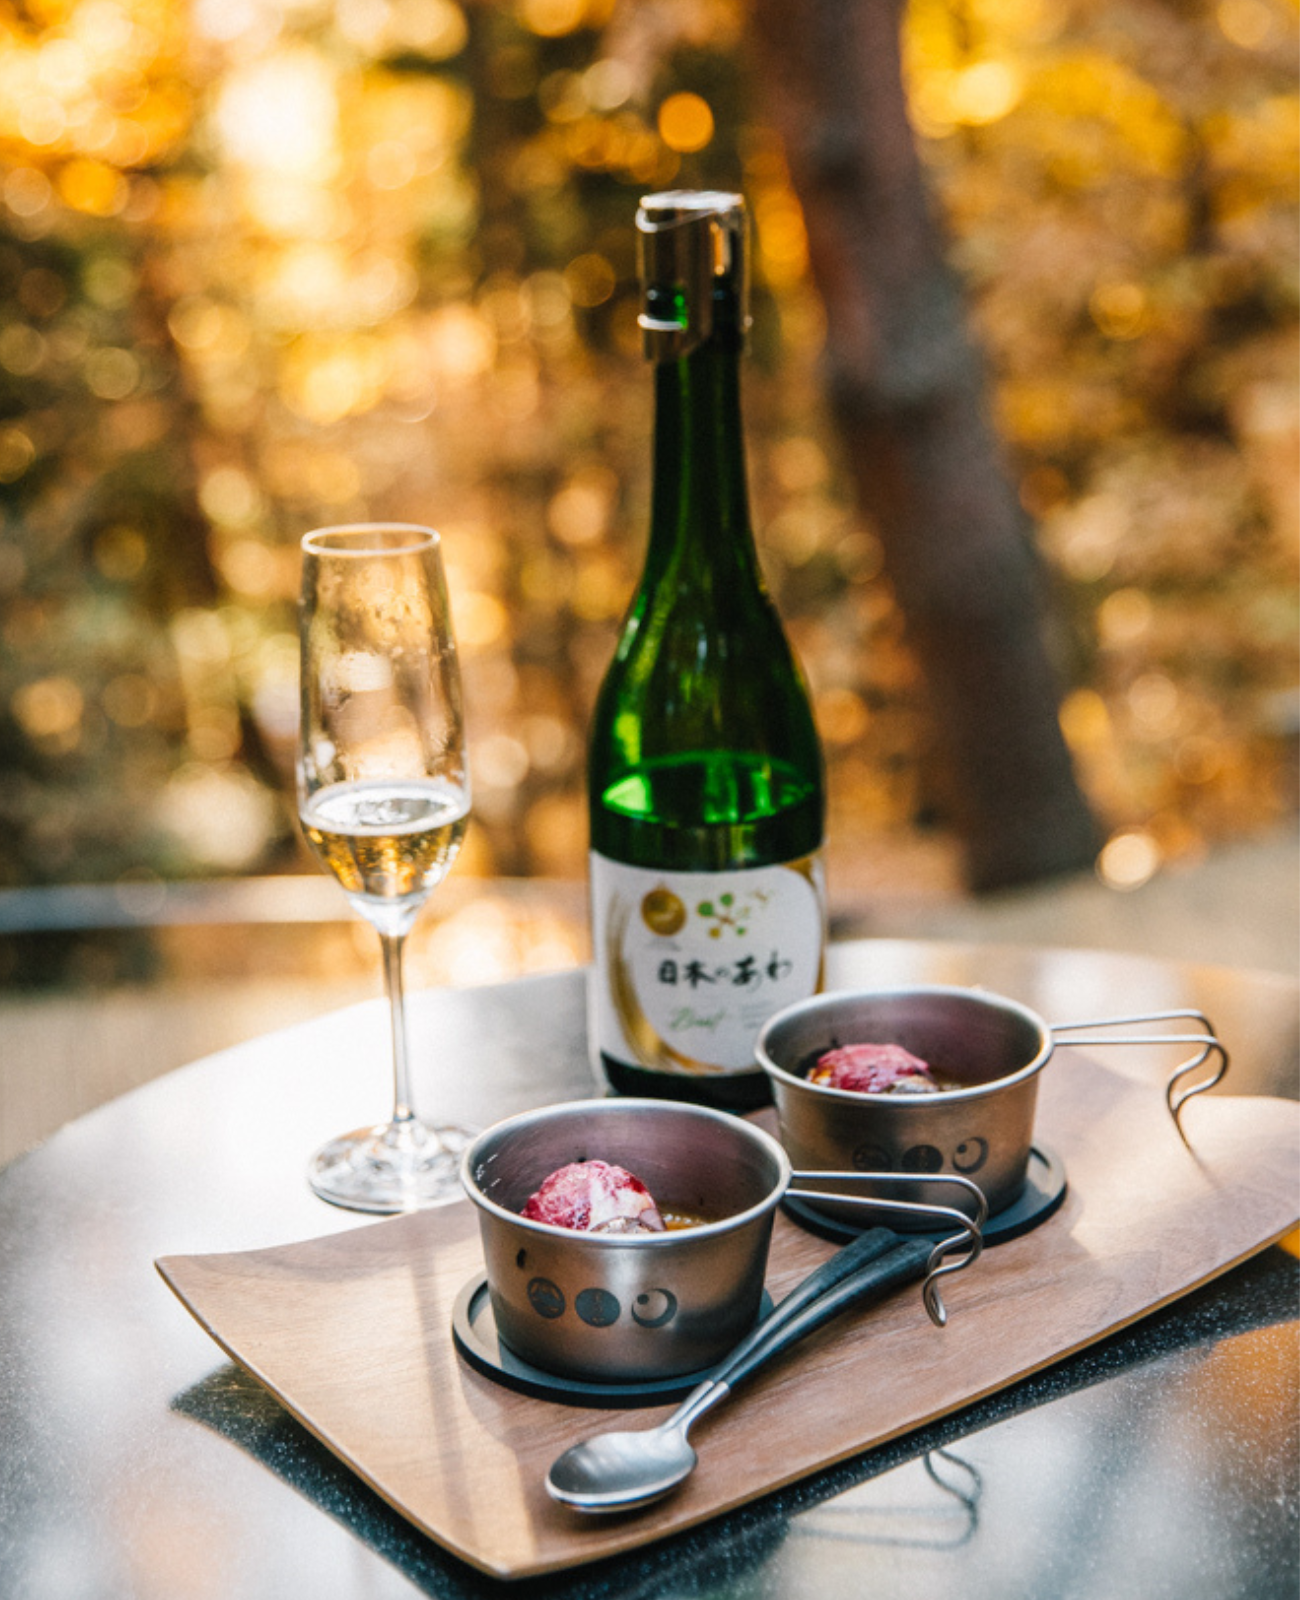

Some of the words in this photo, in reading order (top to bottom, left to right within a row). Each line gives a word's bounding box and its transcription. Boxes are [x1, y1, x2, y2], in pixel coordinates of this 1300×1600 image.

[658, 951, 793, 992] 日本のあわ
